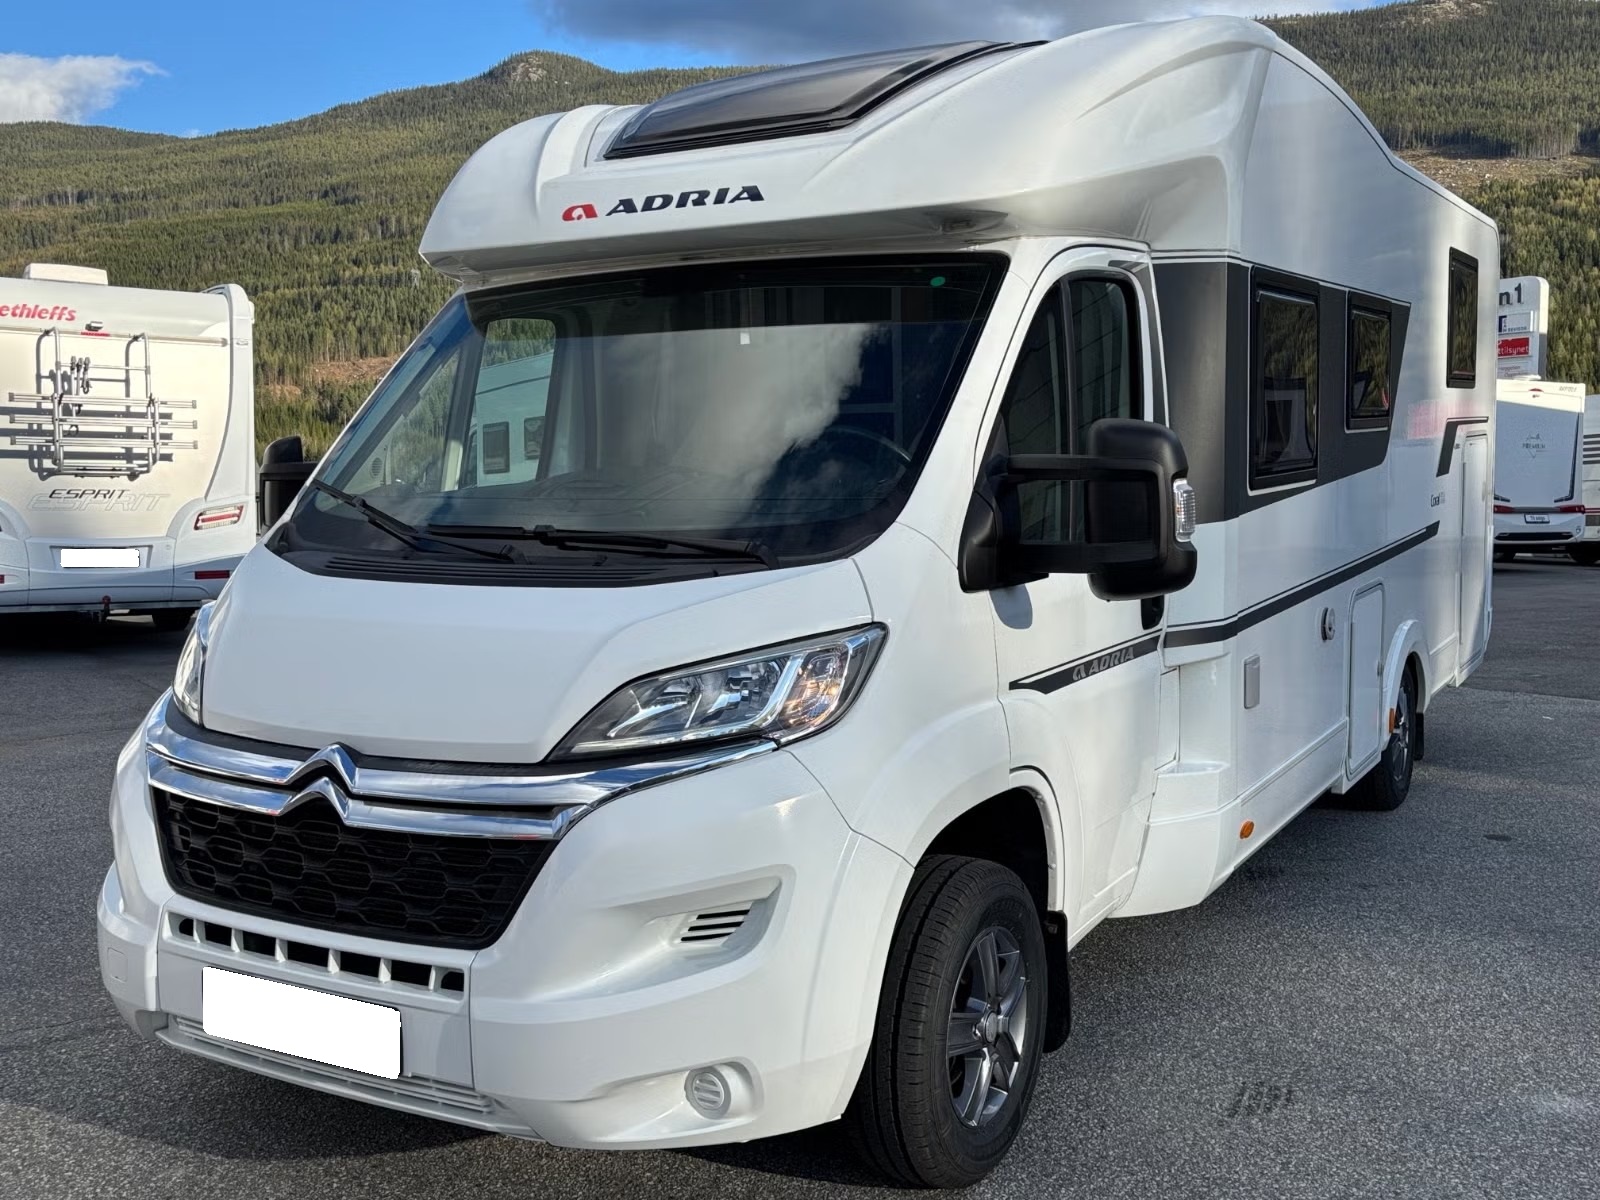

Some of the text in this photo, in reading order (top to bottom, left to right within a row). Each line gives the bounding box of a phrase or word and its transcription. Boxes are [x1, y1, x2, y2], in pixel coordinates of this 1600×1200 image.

[605, 185, 765, 216] ADRIA
[49, 488, 131, 499] ESPRIT
[1088, 647, 1135, 676] ADRIA
